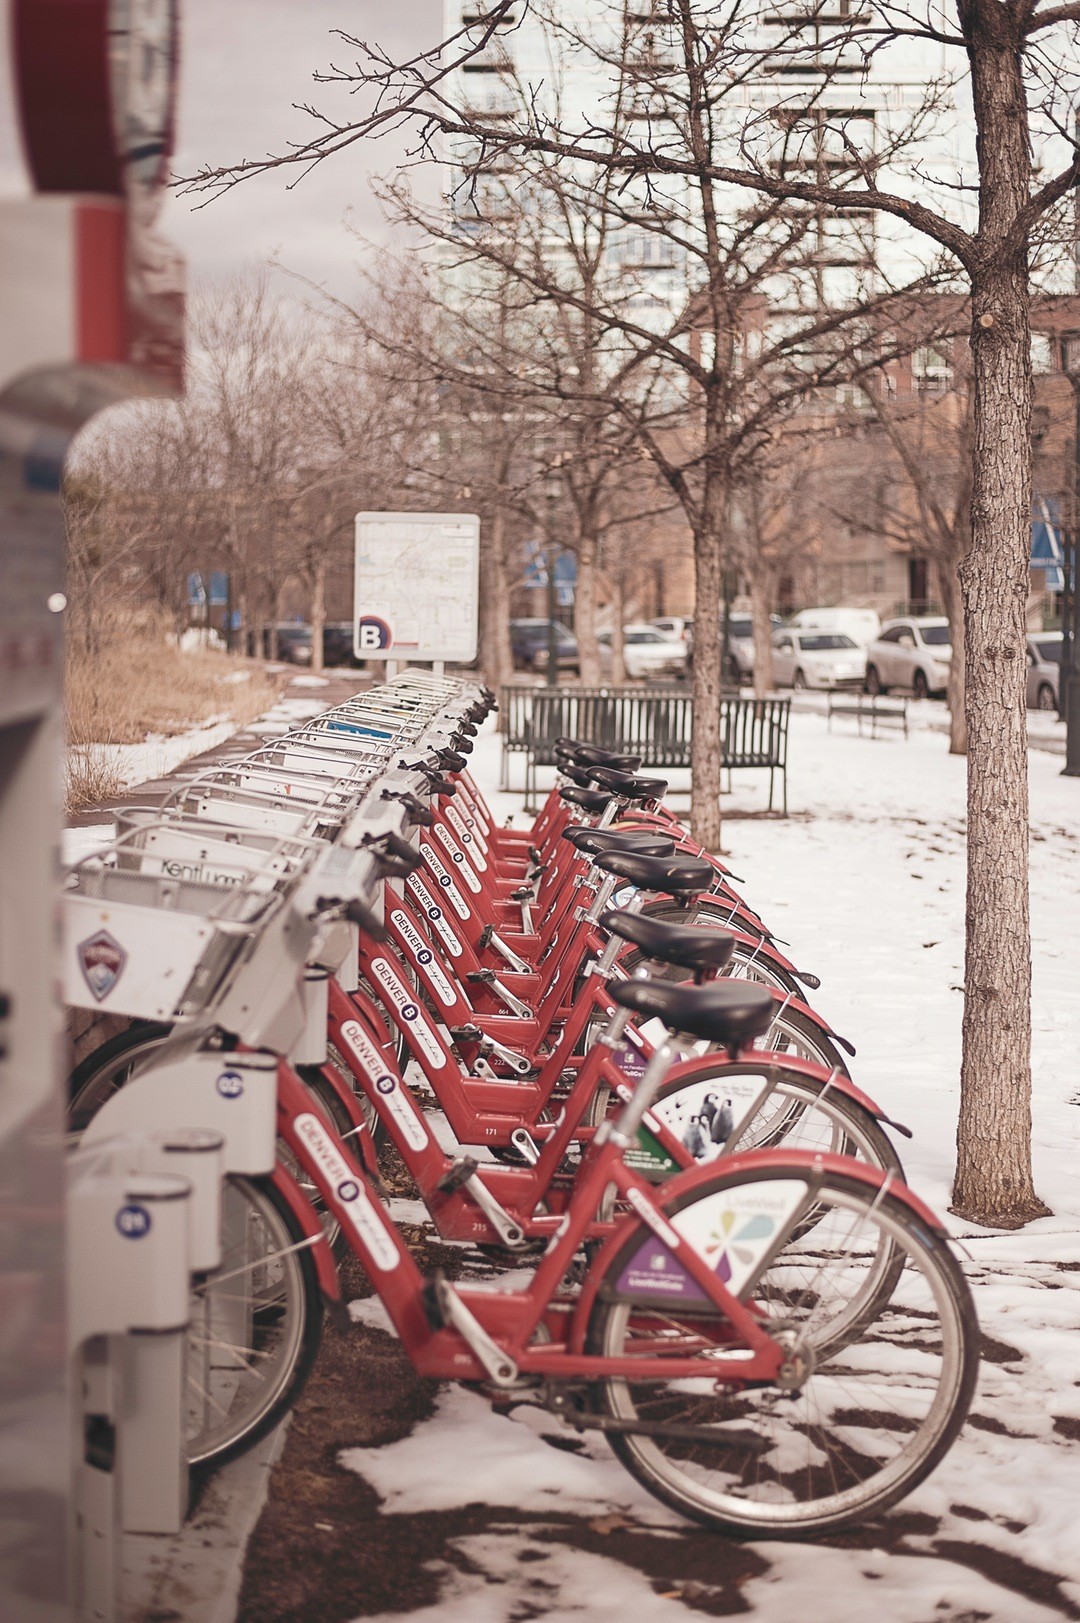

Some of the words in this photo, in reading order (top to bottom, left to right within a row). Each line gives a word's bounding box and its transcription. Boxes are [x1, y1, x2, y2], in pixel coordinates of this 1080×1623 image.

[361, 625, 381, 650] B
[436, 825, 457, 853] DENVER
[421, 846, 444, 876] DENVER
[408, 875, 433, 908] DENVER
[394, 913, 422, 951] DENVER
[375, 962, 407, 1005] DENVER
[346, 1026, 383, 1077] DENVER
[300, 1119, 345, 1182] DENVER
